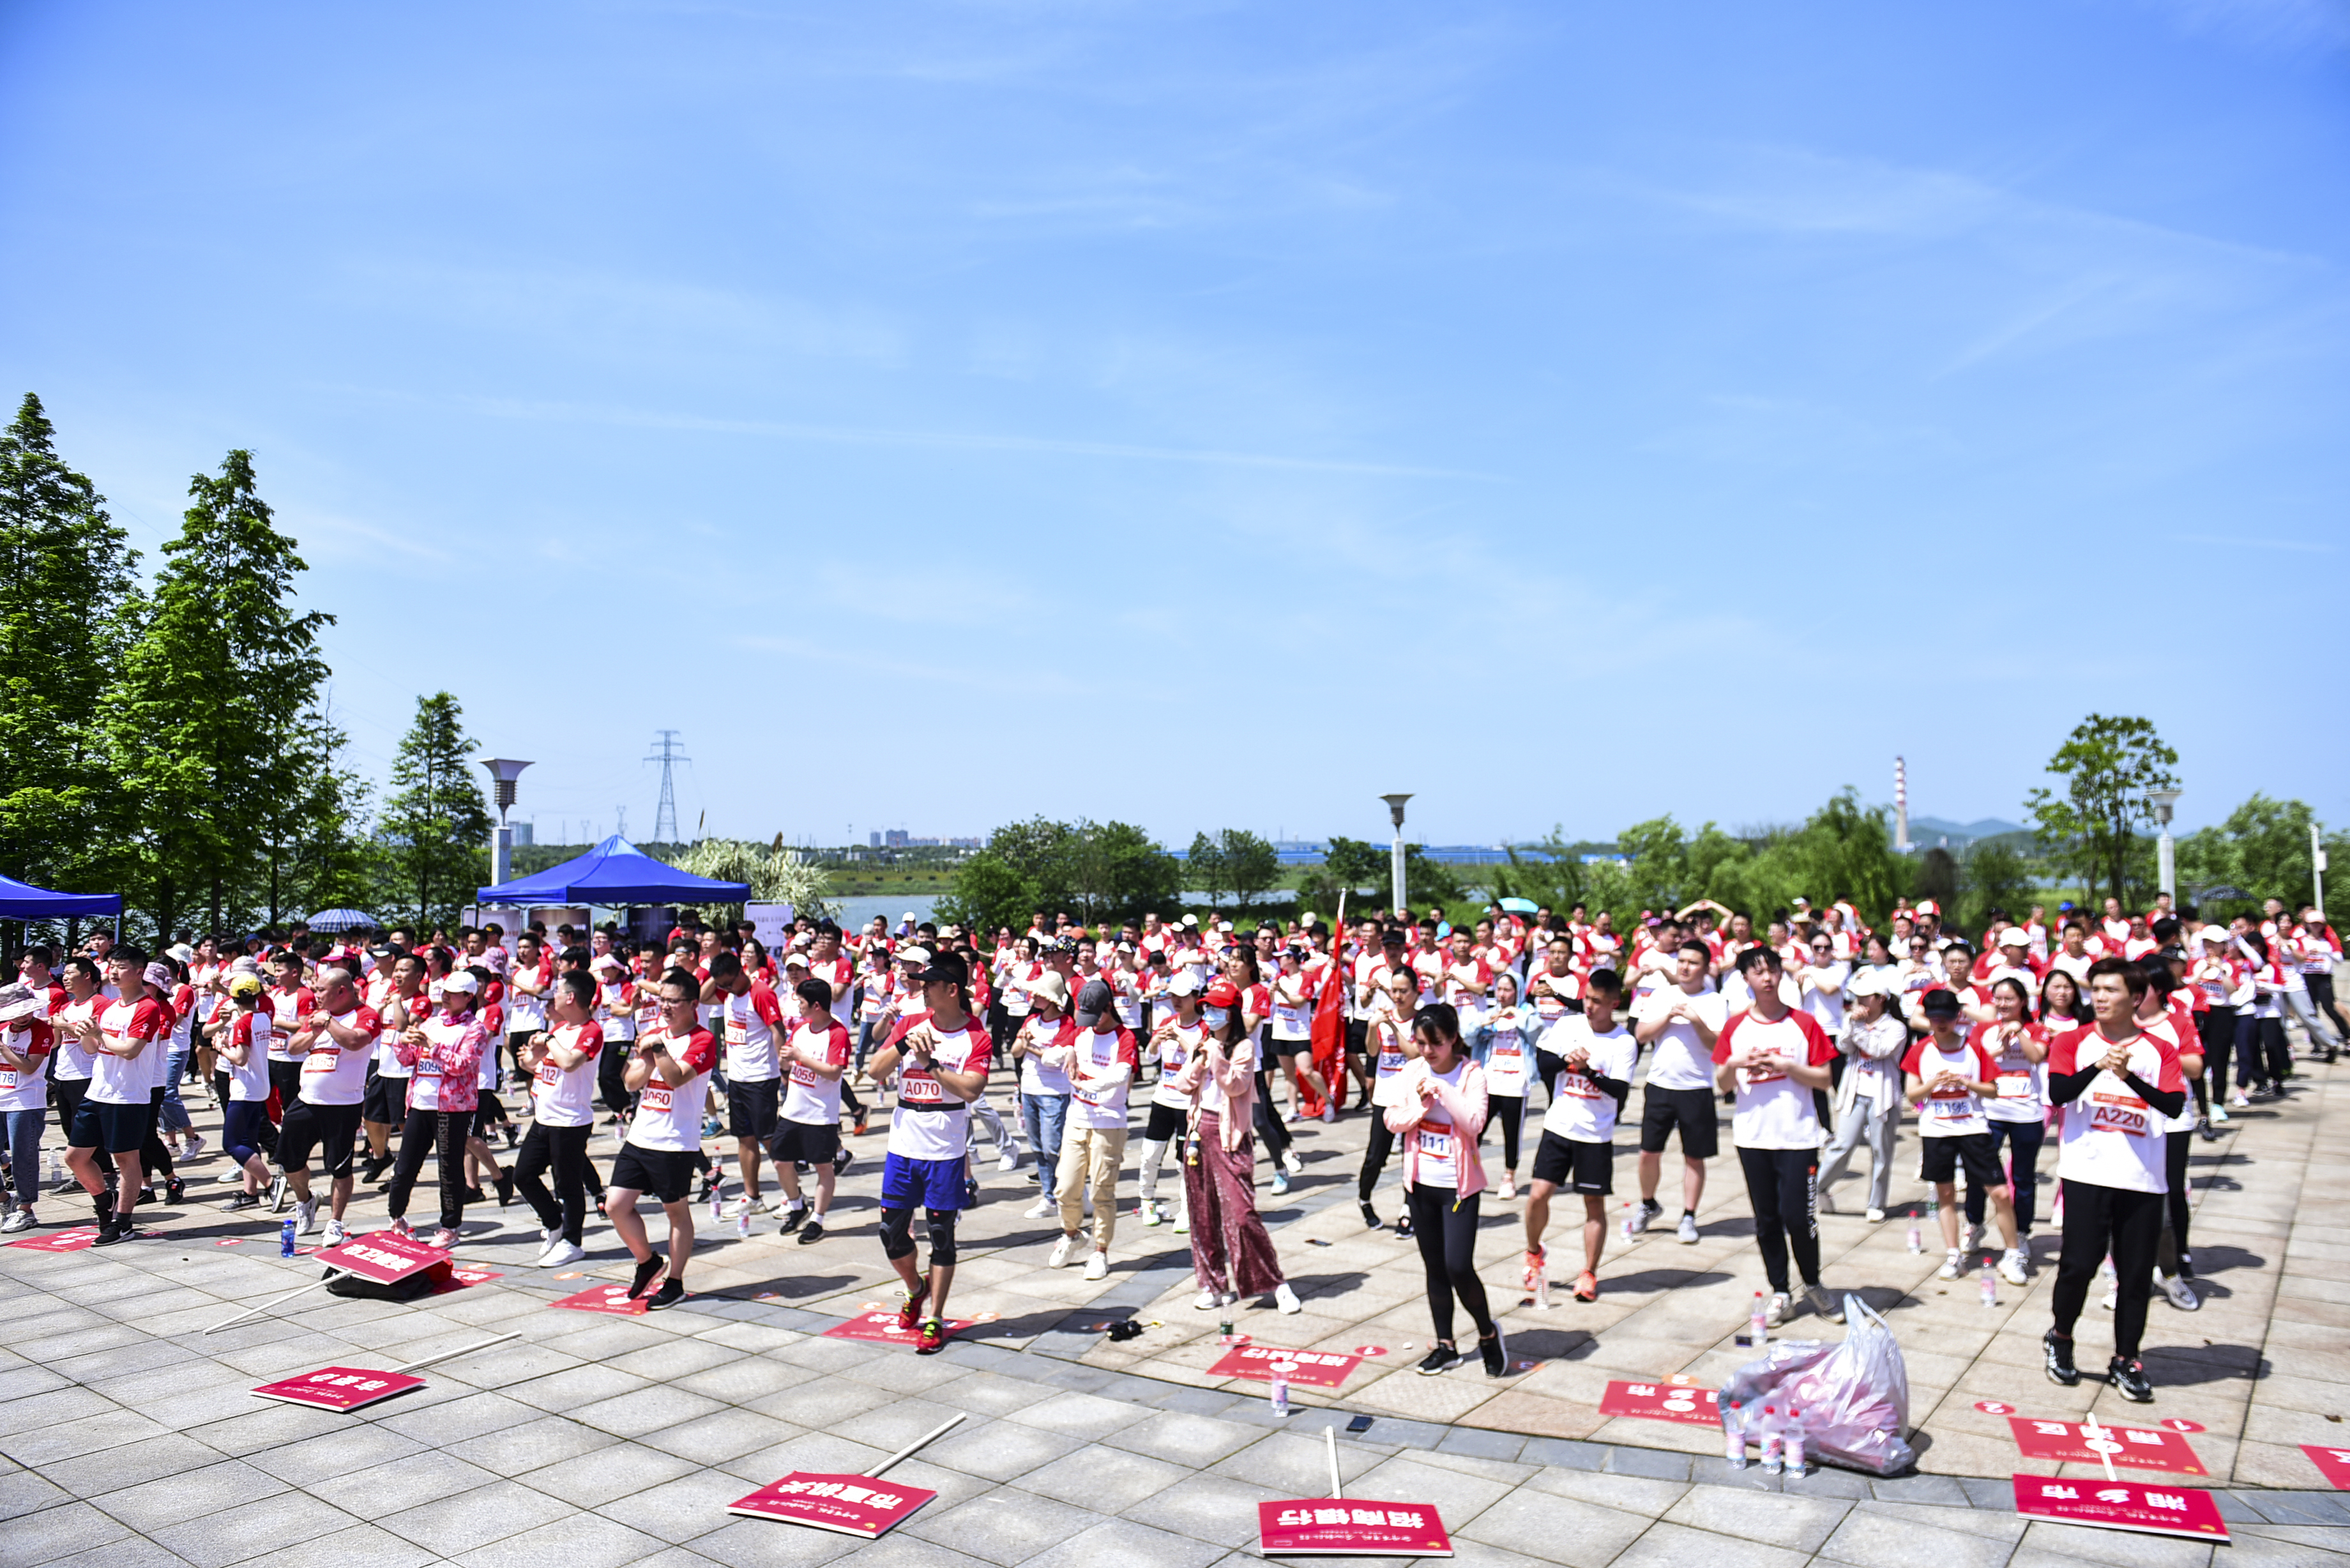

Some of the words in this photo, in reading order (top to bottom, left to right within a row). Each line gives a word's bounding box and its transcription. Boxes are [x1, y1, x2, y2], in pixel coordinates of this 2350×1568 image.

[0, 1073, 14, 1084] 76
[904, 1081, 939, 1096] A070
[2094, 1106, 2144, 1129] A220
[1982, 1402, 2005, 1413] 2
[777, 1480, 904, 1510] 市直机关
[2040, 1484, 2188, 1511] 湘乡市
[1277, 1508, 1425, 1529] 招商银行
